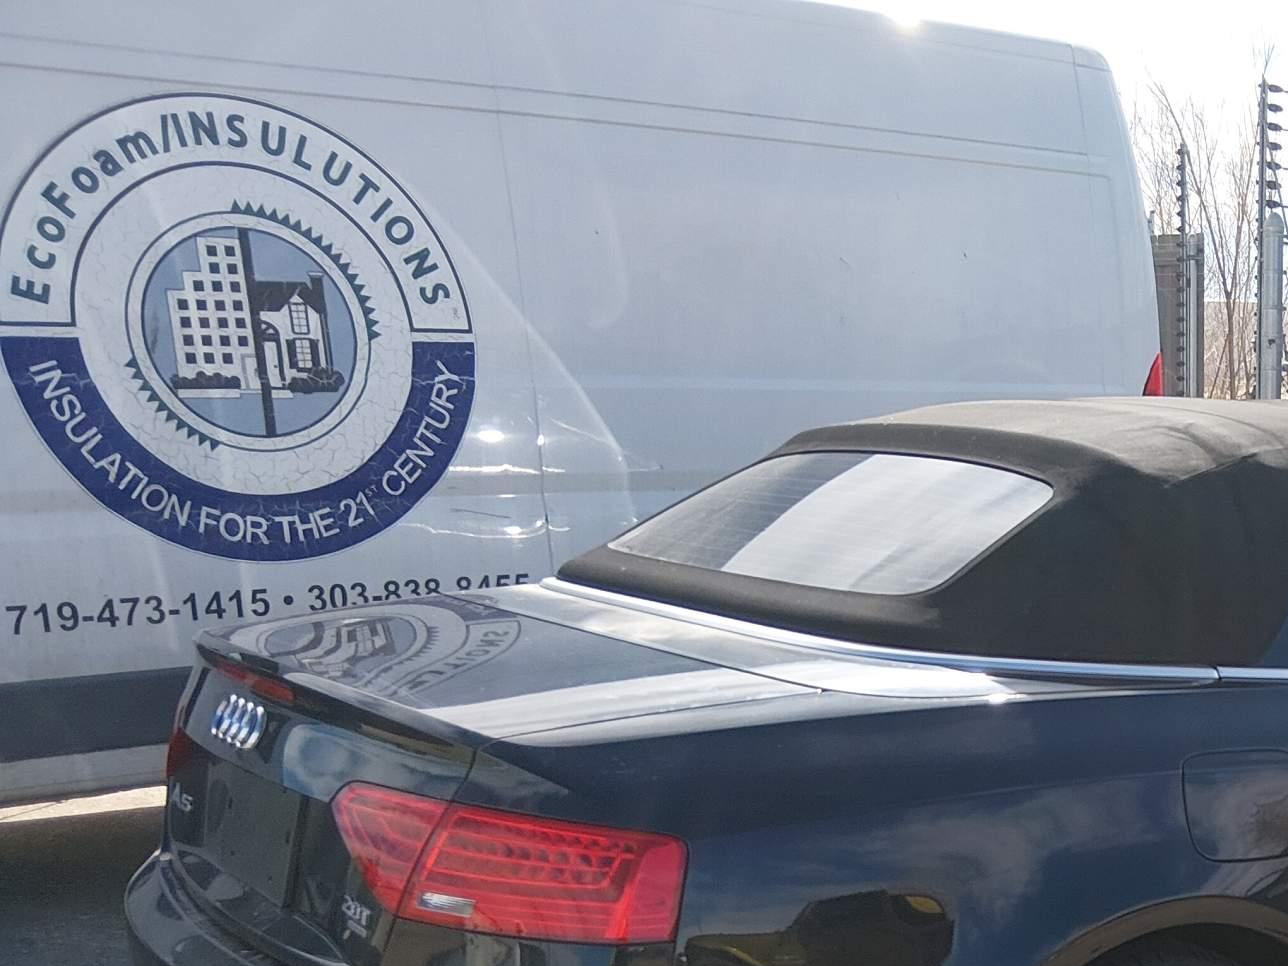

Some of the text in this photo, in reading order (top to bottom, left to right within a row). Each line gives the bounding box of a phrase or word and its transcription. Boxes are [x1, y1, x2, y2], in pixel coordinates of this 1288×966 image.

[29, 359, 191, 527] INSULATION
[199, 506, 269, 545] FOR
[274, 506, 340, 545] THE
[382, 359, 461, 496] CENTURY
[6, 588, 271, 635] 719-473-1415
